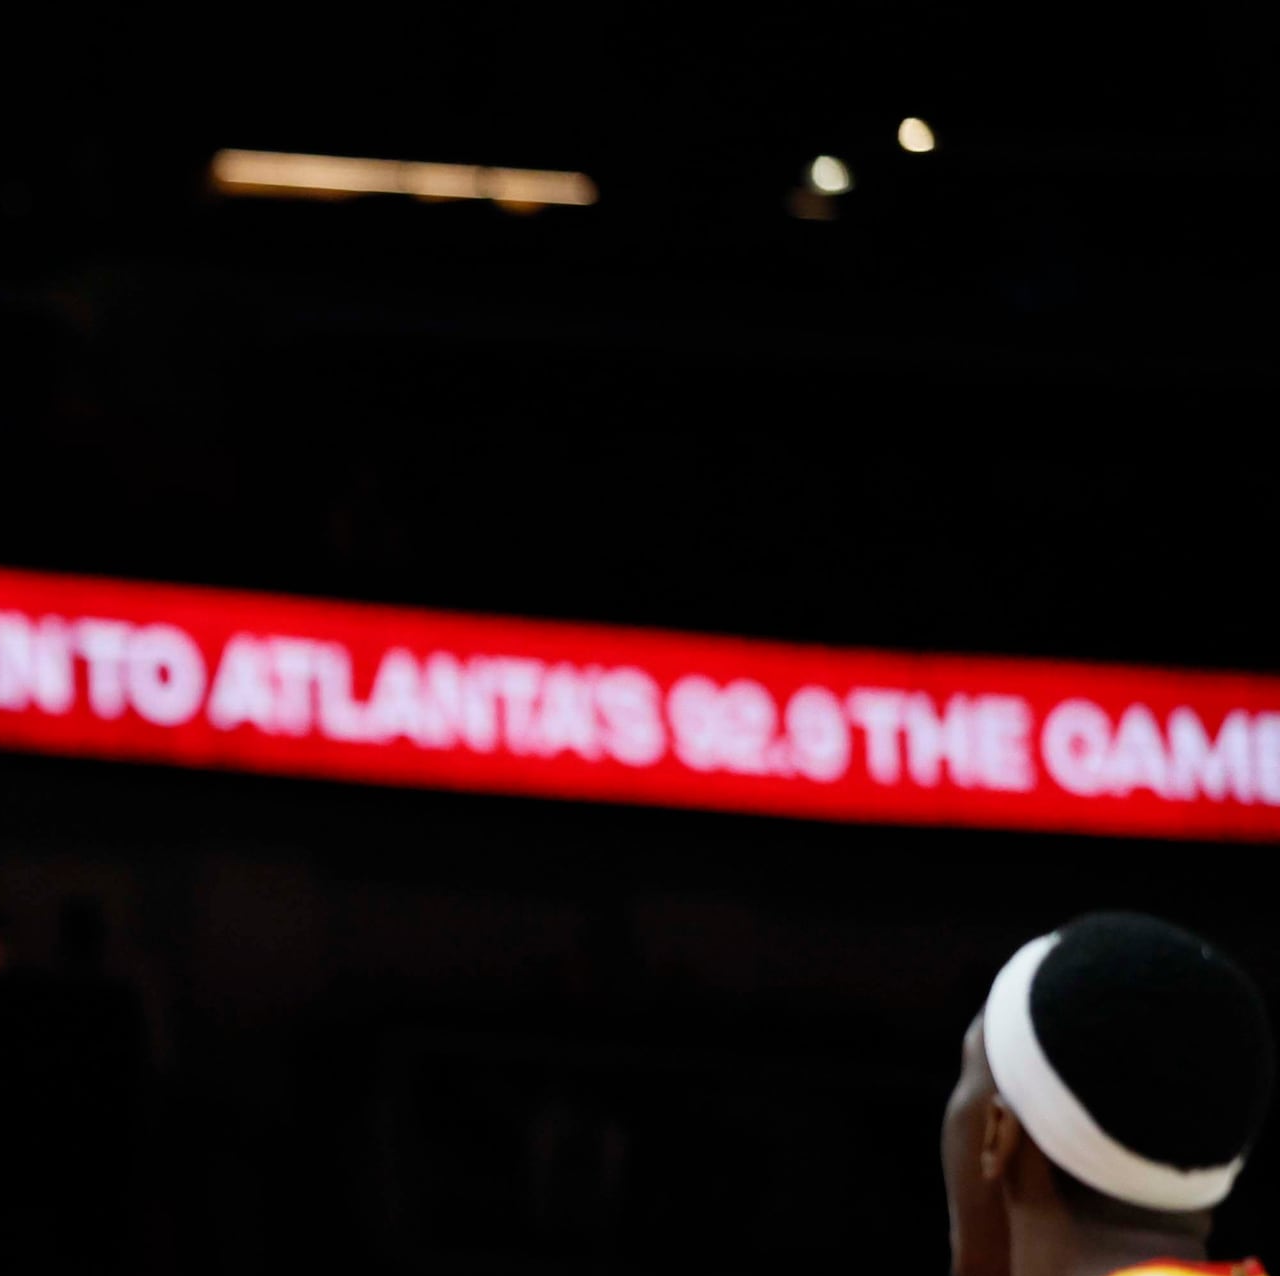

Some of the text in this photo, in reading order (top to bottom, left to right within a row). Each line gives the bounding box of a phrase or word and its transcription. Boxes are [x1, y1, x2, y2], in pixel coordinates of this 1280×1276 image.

[74, 614, 209, 726] TO
[206, 633, 665, 768] ATLANTA'S
[668, 673, 852, 784] 92.9
[844, 685, 1037, 792] THE
